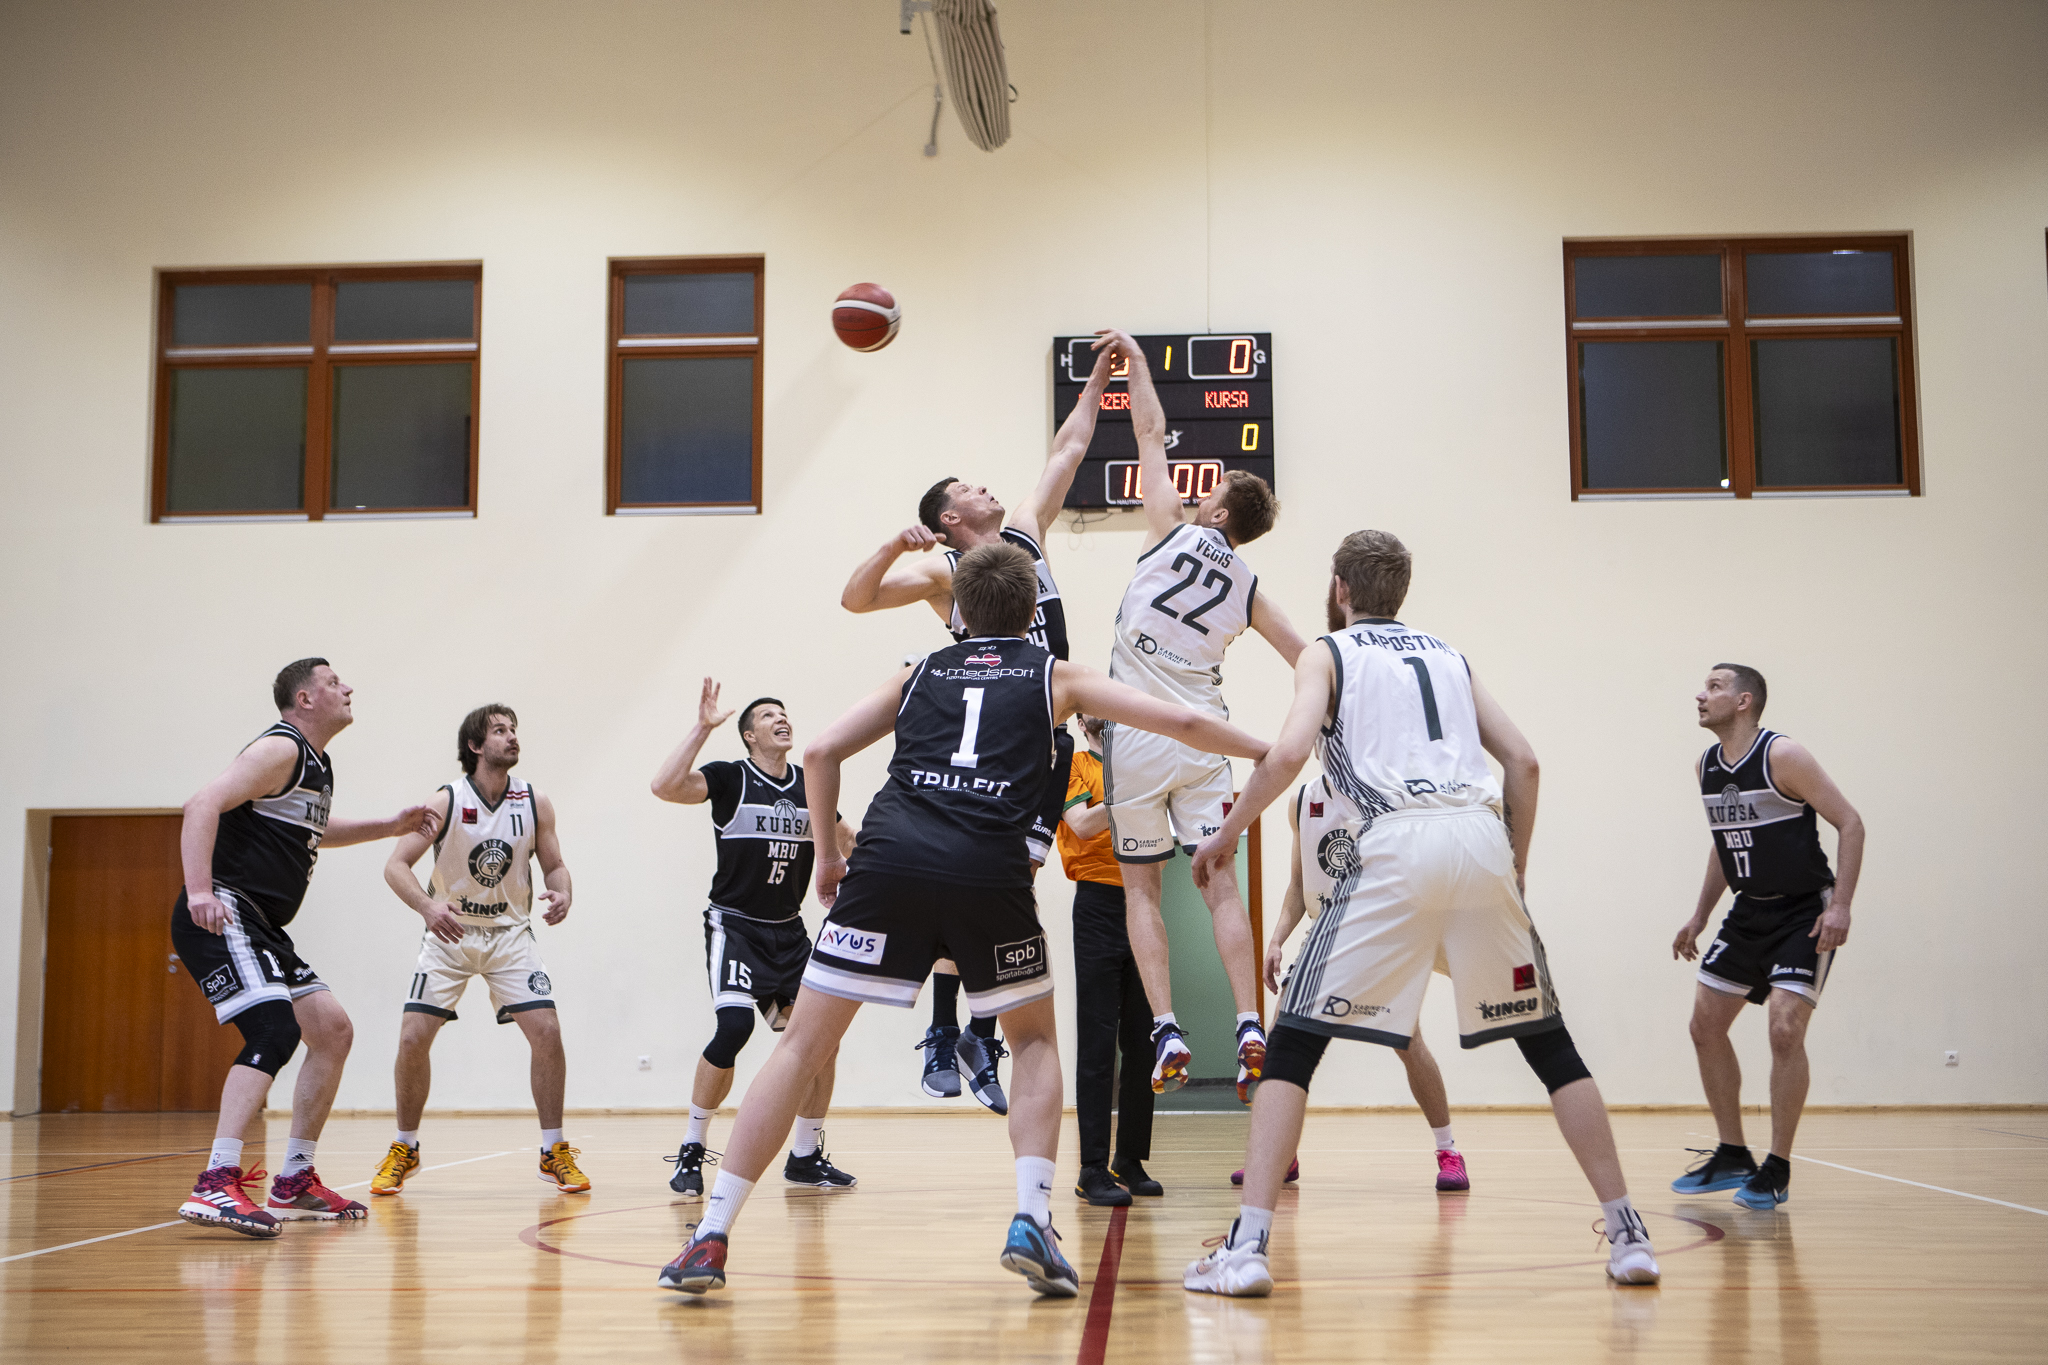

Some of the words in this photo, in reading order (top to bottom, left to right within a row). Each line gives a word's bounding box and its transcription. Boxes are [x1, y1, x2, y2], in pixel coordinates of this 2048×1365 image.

[1060, 353, 1074, 368] H
[1164, 345, 1173, 371] 1
[1229, 339, 1252, 374] 0
[1252, 349, 1267, 364] G
[1204, 391, 1249, 408] KURSA
[1241, 423, 1260, 451] 0
[1196, 537, 1234, 569] VEGIS
[1150, 551, 1233, 636] 22
[1159, 647, 1192, 667] KABINETA
[946, 667, 1035, 678] medsport
[1402, 656, 1443, 742] 1
[950, 687, 985, 769] 1
[509, 813, 524, 837] 11
[1707, 803, 1760, 824] KURSA
[767, 841, 799, 860] MRU
[1722, 829, 1754, 849] MRU
[767, 860, 789, 885] 15
[1732, 851, 1751, 878] 17
[461, 901, 509, 916] KINGU
[822, 930, 876, 953] AVUS
[262, 948, 286, 979] 1
[1005, 944, 1035, 967] spb
[206, 974, 227, 993] spb
[409, 972, 428, 1000] 11
[727, 959, 753, 990] 15
[1482, 997, 1538, 1019] KINGU
